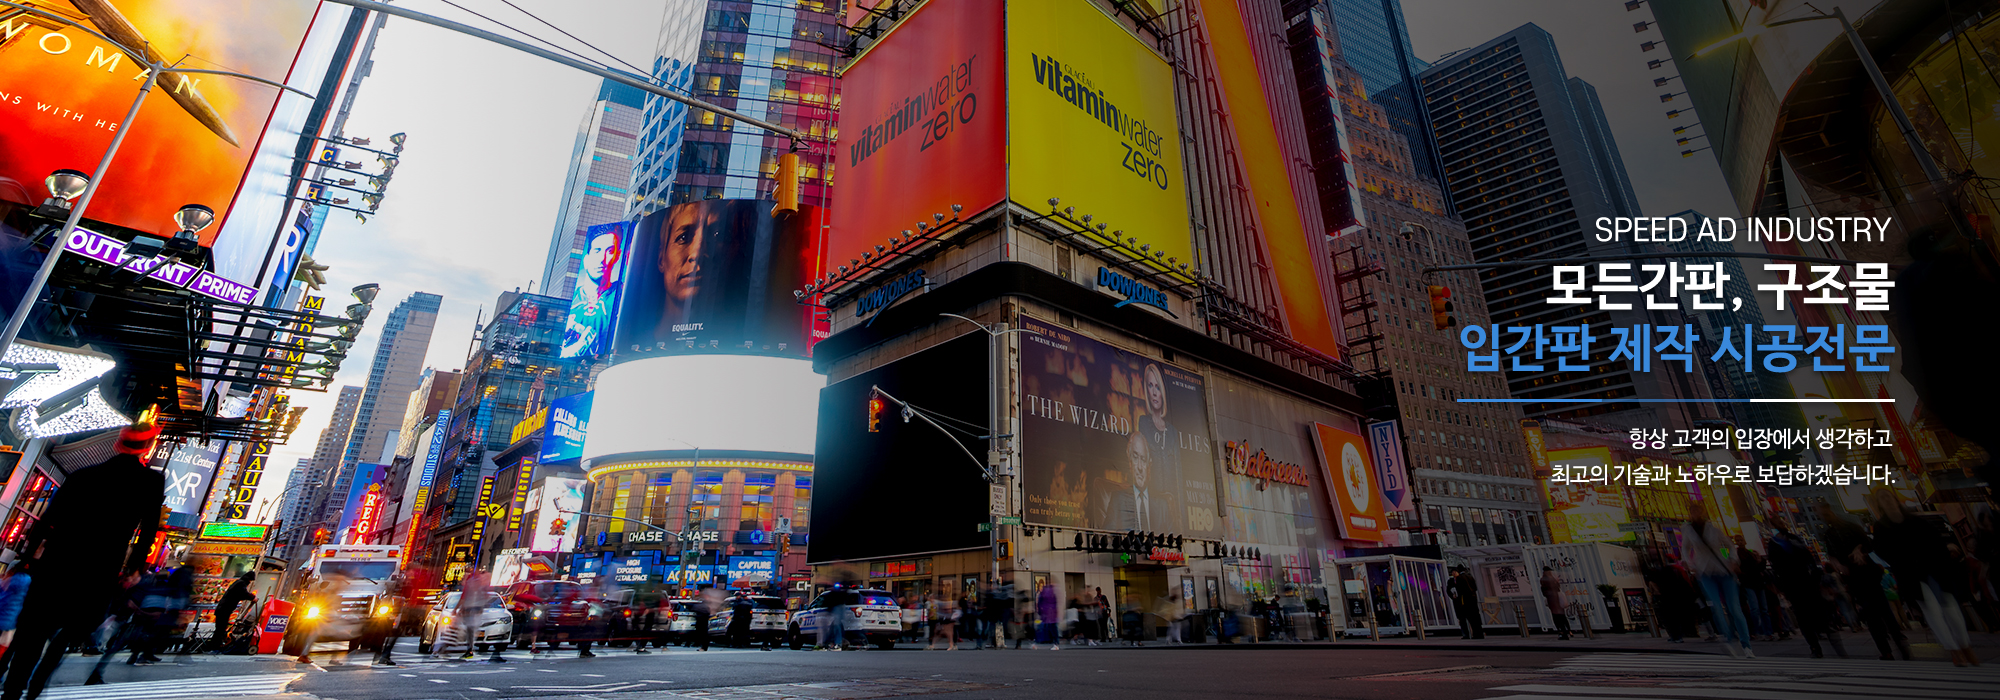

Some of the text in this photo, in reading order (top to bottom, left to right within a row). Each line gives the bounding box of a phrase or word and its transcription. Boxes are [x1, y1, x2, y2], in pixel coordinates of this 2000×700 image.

[37, 102, 84, 122] WITH
[95, 118, 118, 132] HE
[920, 92, 977, 152] zero
[1121, 141, 1168, 190] zero
[198, 273, 253, 303] PRIME
[672, 322, 704, 332] EQUALITY.
[1026, 322, 1071, 343] ROBERT DE NIRO
[436, 410, 451, 427] NEW
[1027, 394, 1211, 454] THE WIZARD of LIES
[208, 440, 221, 454] York
[157, 446, 217, 472] the 21st Century
[1225, 438, 1316, 492] Walgreens
[1379, 427, 1397, 489] NYPD
[420, 453, 439, 486] STUDIOS
[164, 495, 188, 506] ALTY
[508, 459, 533, 529] NEW VICTORY
[1029, 494, 1041, 506] Only
[354, 494, 378, 545] REGA
[1003, 517, 1020, 525] Broadway
[1187, 506, 1214, 532] HBO
[471, 521, 484, 540] NEW
[628, 531, 664, 542] CHASE
[677, 531, 720, 542] CHASE
[728, 570, 743, 579] THE
[738, 561, 772, 570] CAPTURE
[632, 574, 648, 582] SPACE
[667, 570, 711, 582] ACTION
[270, 616, 289, 625] VOICE
